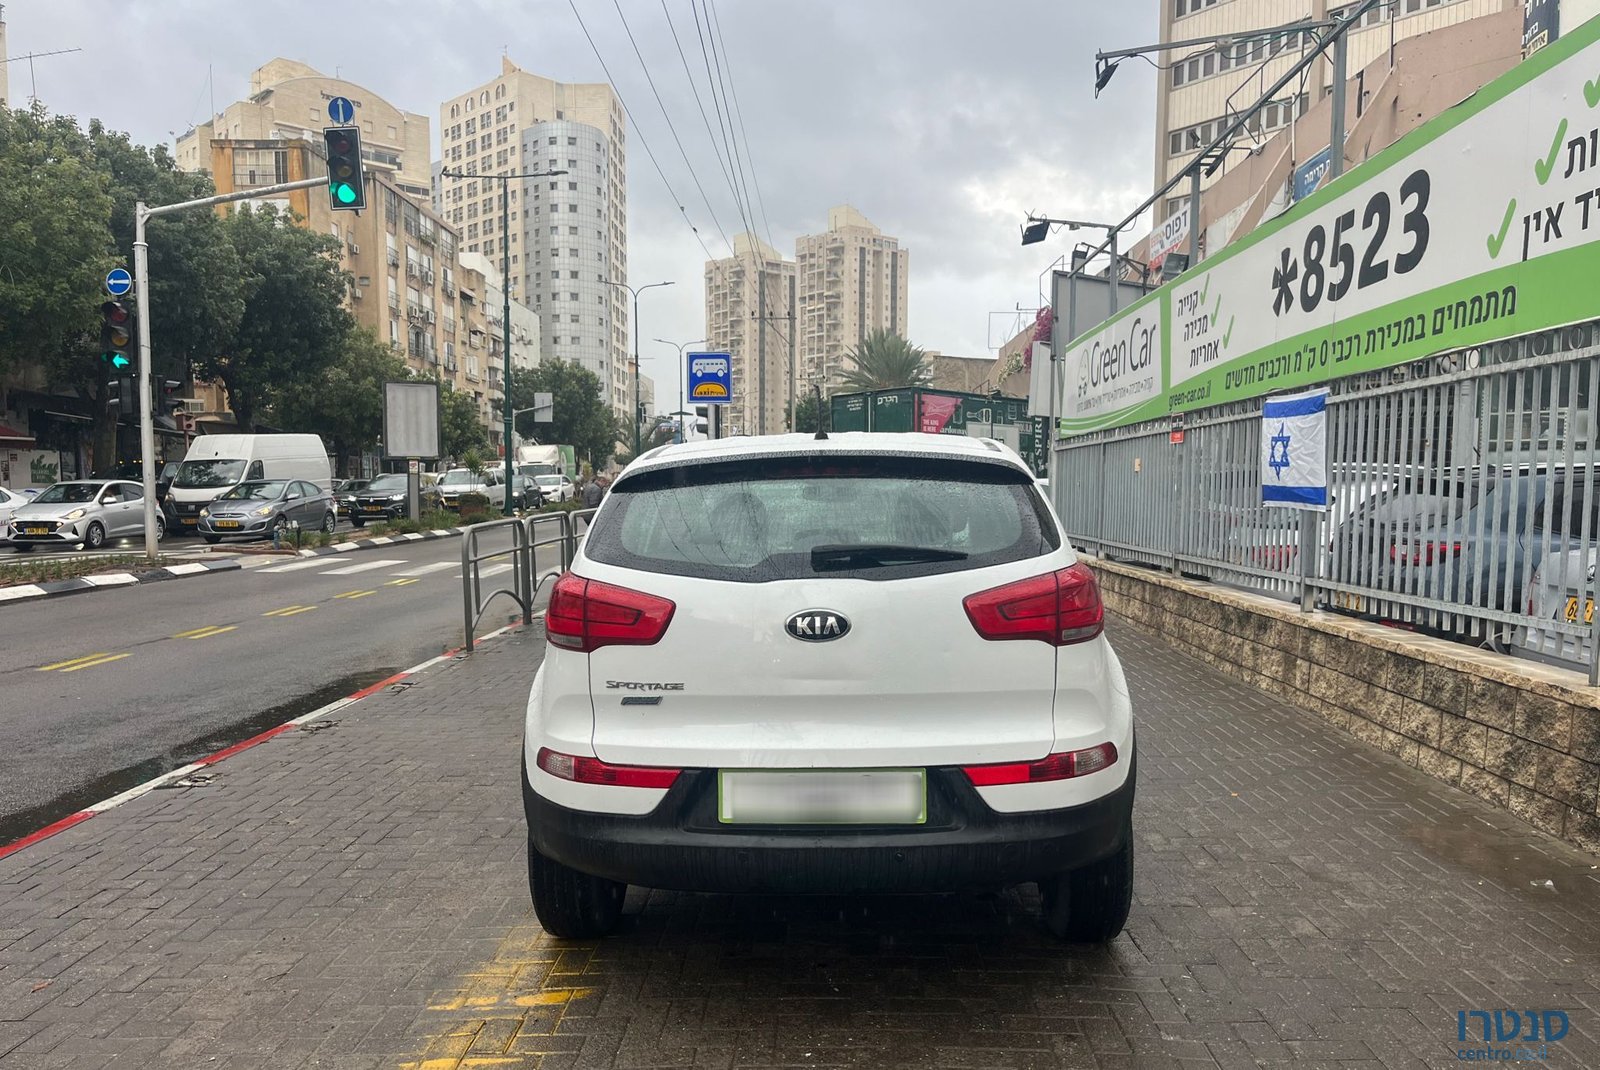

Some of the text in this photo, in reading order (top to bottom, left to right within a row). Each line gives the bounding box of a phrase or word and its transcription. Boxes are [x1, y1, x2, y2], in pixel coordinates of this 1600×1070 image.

[1165, 210, 1188, 240] דפוס
[1522, 201, 1565, 262] אין
[1178, 290, 1199, 317] קנייה
[1432, 285, 1516, 336] מתמחים
[1184, 314, 1209, 342] מכירה
[1365, 313, 1426, 355] במכירת
[1091, 317, 1157, 388] Green Car
[1190, 339, 1220, 368] אחריות
[1320, 339, 1328, 367] 0
[1332, 334, 1361, 363] רכבי
[1225, 365, 1256, 390] חדשים
[1258, 354, 1291, 382] ורכבים
[1169, 381, 1212, 411] green-car.co.il
[796, 616, 841, 636] KIA
[606, 680, 685, 692] SPORTAGE
